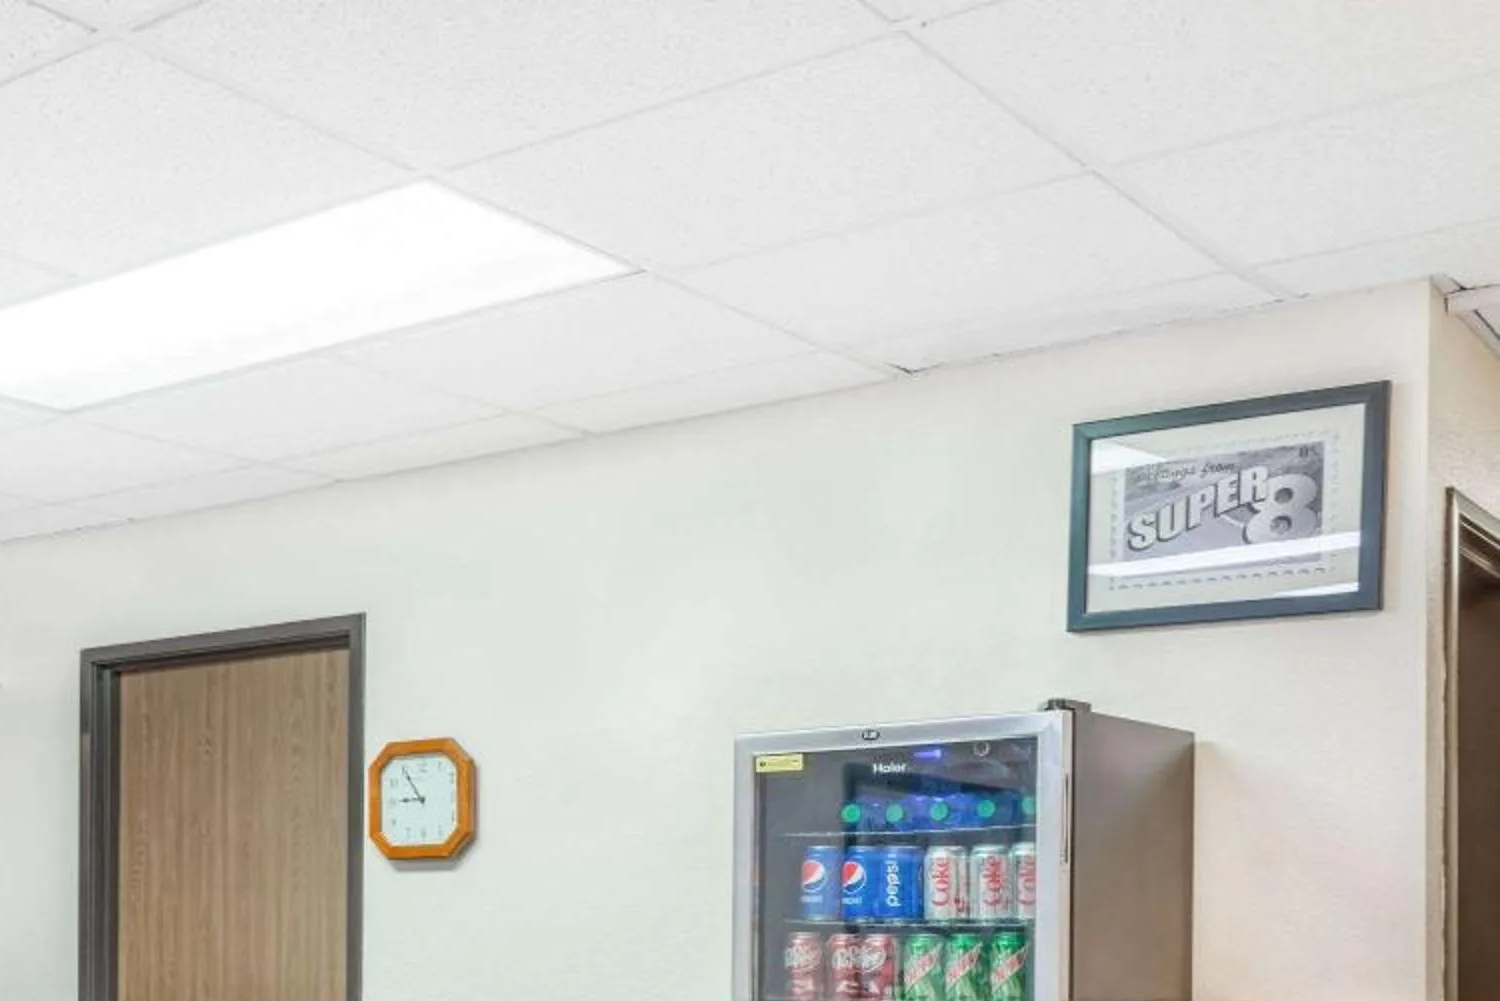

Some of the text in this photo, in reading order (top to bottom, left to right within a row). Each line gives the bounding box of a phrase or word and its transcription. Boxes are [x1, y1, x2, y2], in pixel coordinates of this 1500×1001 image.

[1127, 465, 1319, 551] SUPER 8
[873, 762, 907, 774] Haier
[886, 853, 901, 907] pepsi
